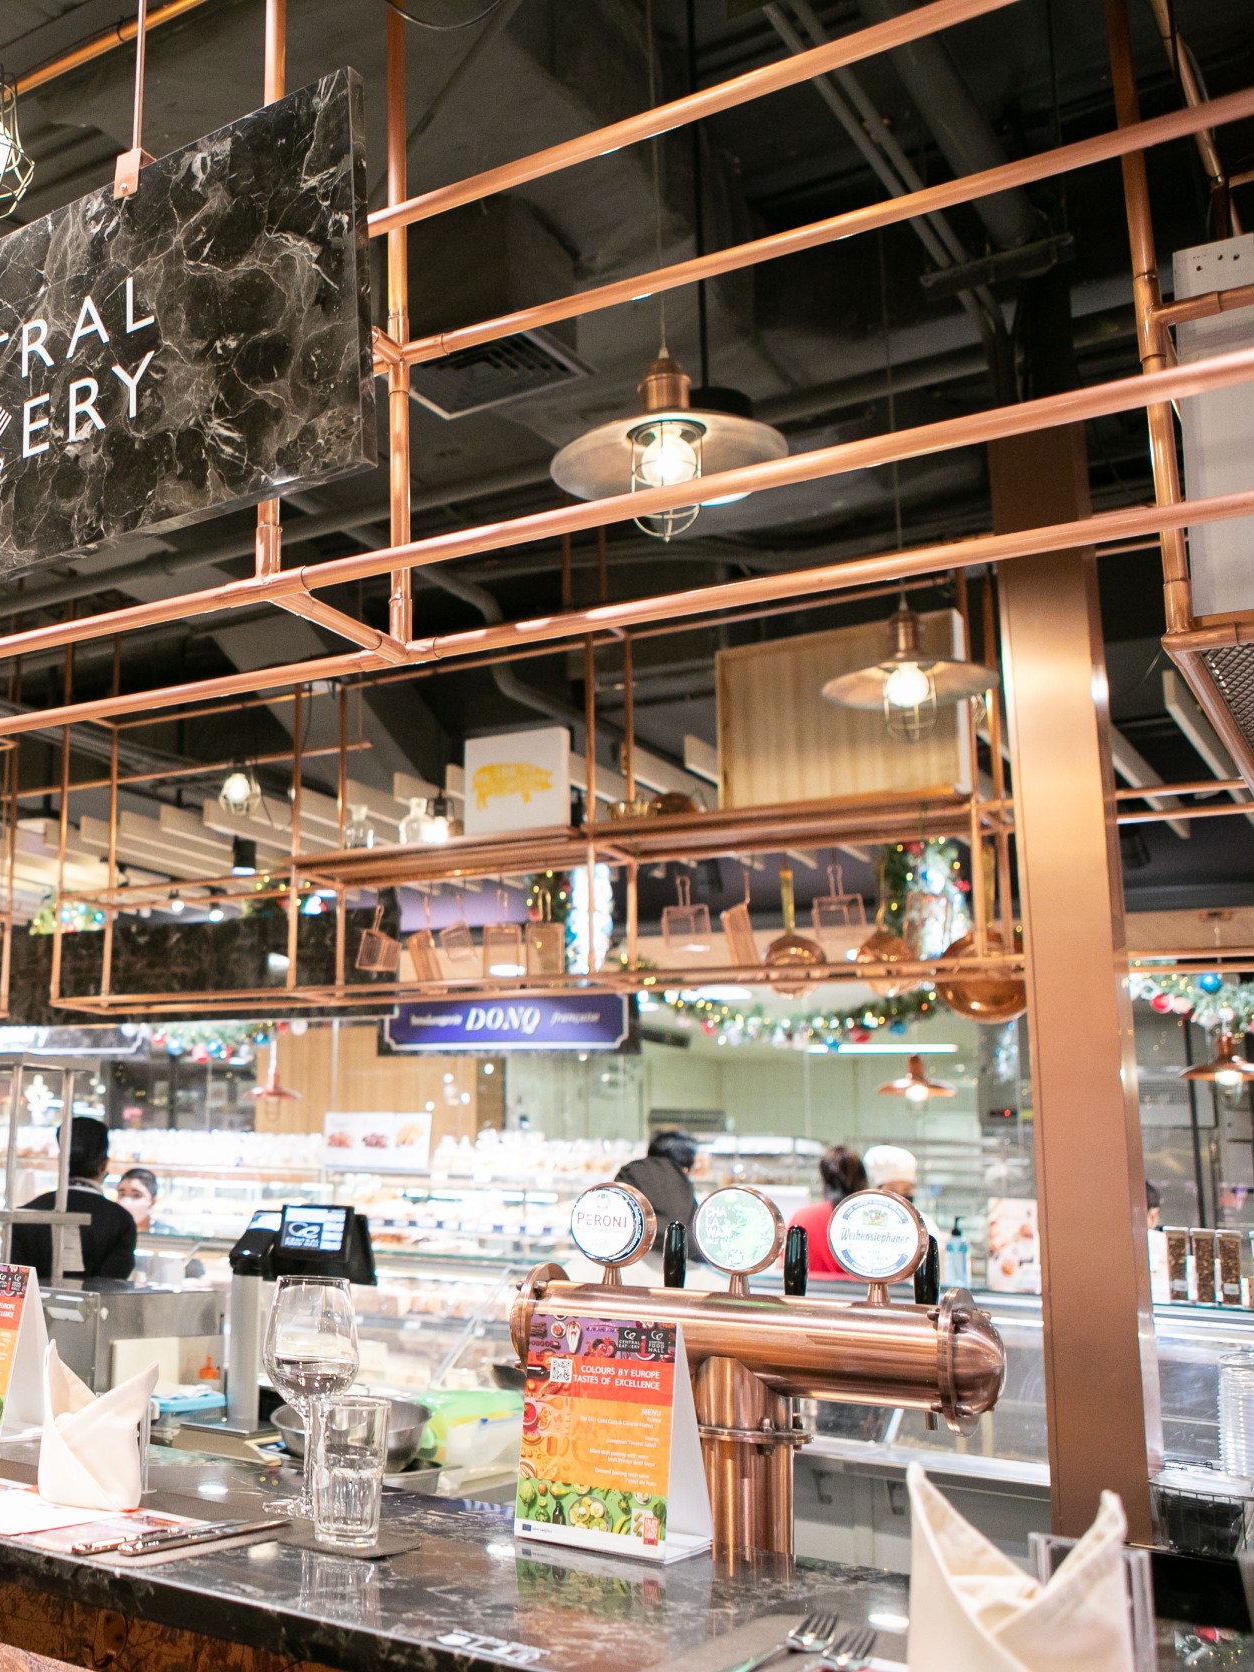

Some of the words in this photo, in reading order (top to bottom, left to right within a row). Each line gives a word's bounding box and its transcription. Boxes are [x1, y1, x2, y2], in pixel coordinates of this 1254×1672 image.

[465, 1006, 541, 1035] DONQ
[577, 1212, 627, 1228] PERONI
[581, 1365, 615, 1376] COLOURS
[618, 1367, 629, 1377] BY
[630, 1368, 660, 1380] EUROPE
[573, 1374, 599, 1384] TASTES
[600, 1376, 611, 1385] OF
[614, 1377, 660, 1390] EXCELLENCE
[642, 1408, 662, 1416] MENU
